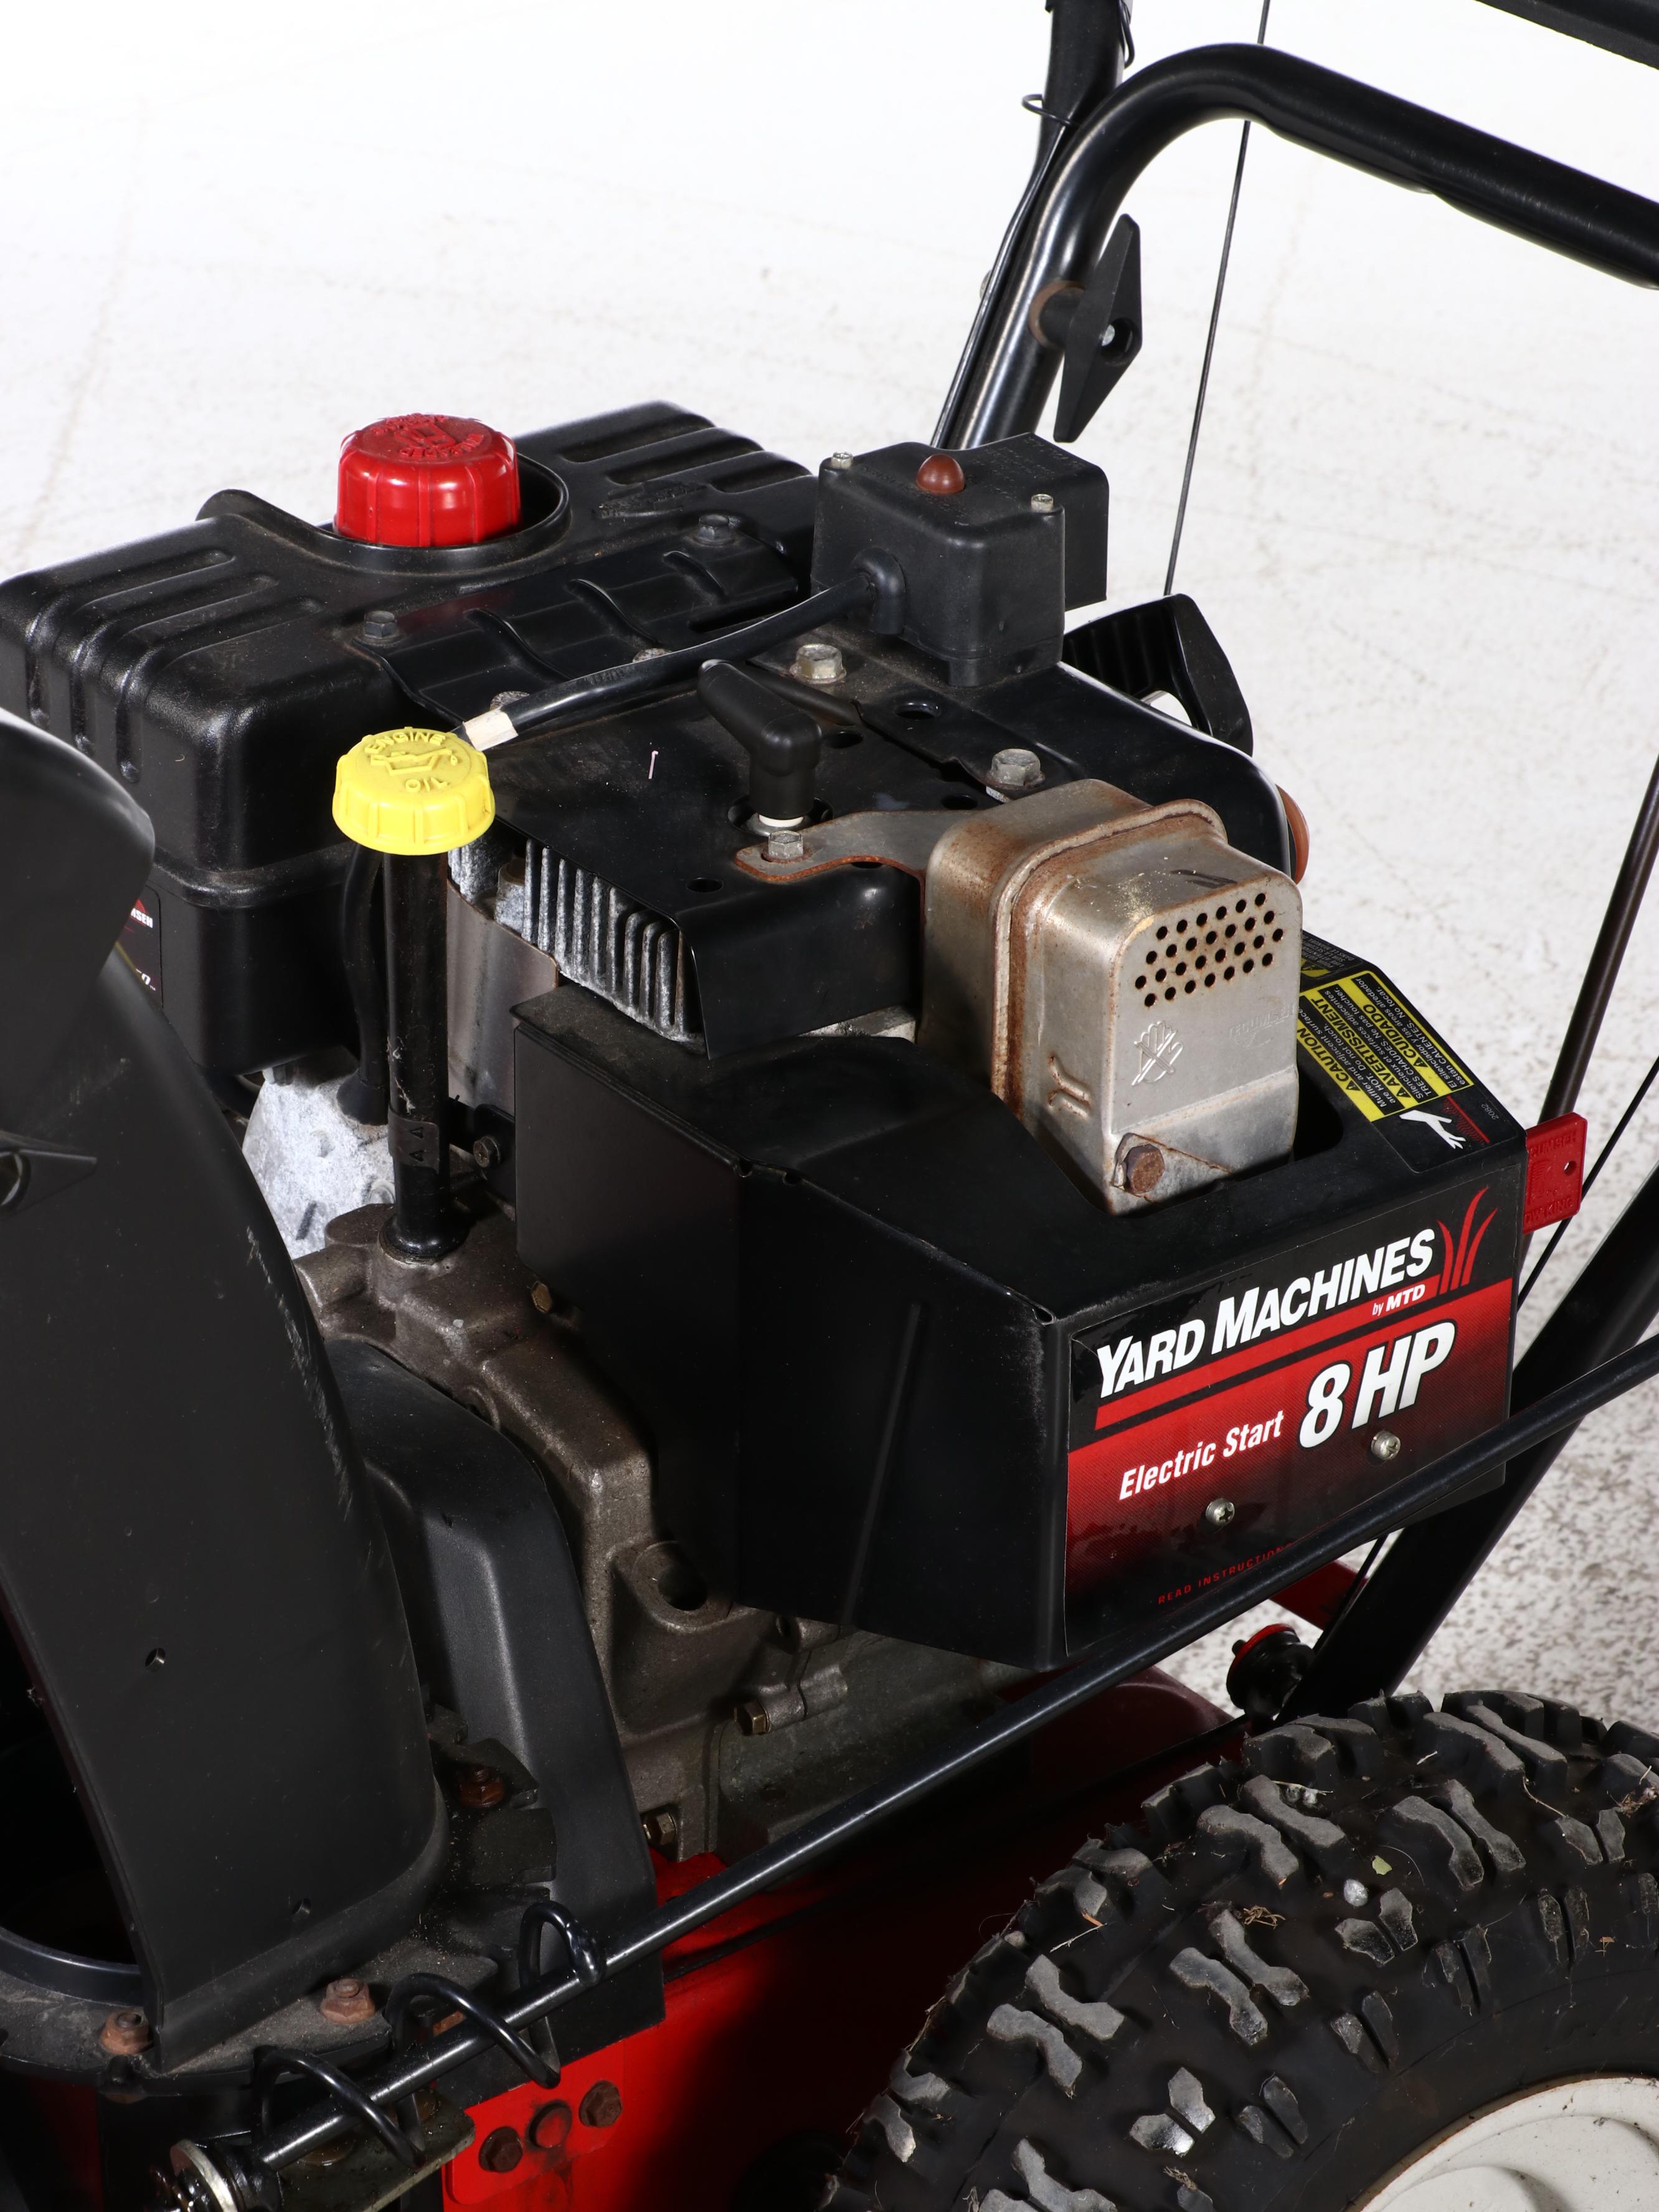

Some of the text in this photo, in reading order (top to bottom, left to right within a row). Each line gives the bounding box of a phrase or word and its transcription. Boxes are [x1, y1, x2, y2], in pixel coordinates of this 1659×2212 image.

[364, 731, 450, 793] ENGINE OIL
[1325, 990, 1359, 1026] adjacentes
[1358, 1015, 1374, 1028] pas
[1394, 1007, 1406, 1018] No
[1310, 998, 1400, 1086] AVERTISSMENT
[1357, 1026, 1385, 1055] surfaces
[1363, 1004, 1417, 1059] CUIDADO
[1371, 1029, 1382, 1039] Ne
[1401, 1027, 1413, 1038] las
[1297, 1028, 1349, 1082] CAUTION
[1298, 1006, 1387, 1107] Muffler and adjacent surface
[1342, 1046, 1356, 1059] not
[1354, 1060, 1366, 1071] Do
[1416, 1044, 1450, 1080] silenciador
[1382, 1092, 1396, 1104] are
[1391, 1064, 1424, 1099] Silencieux
[1447, 1080, 1457, 1088] El
[1097, 1229, 1435, 1399] YARD MACHINES
[1372, 1283, 1426, 1317] by MTD
[1119, 1321, 1456, 1501] Electric Start 8 HP
[1158, 1542, 1294, 1605] READ INSTRUCTION
